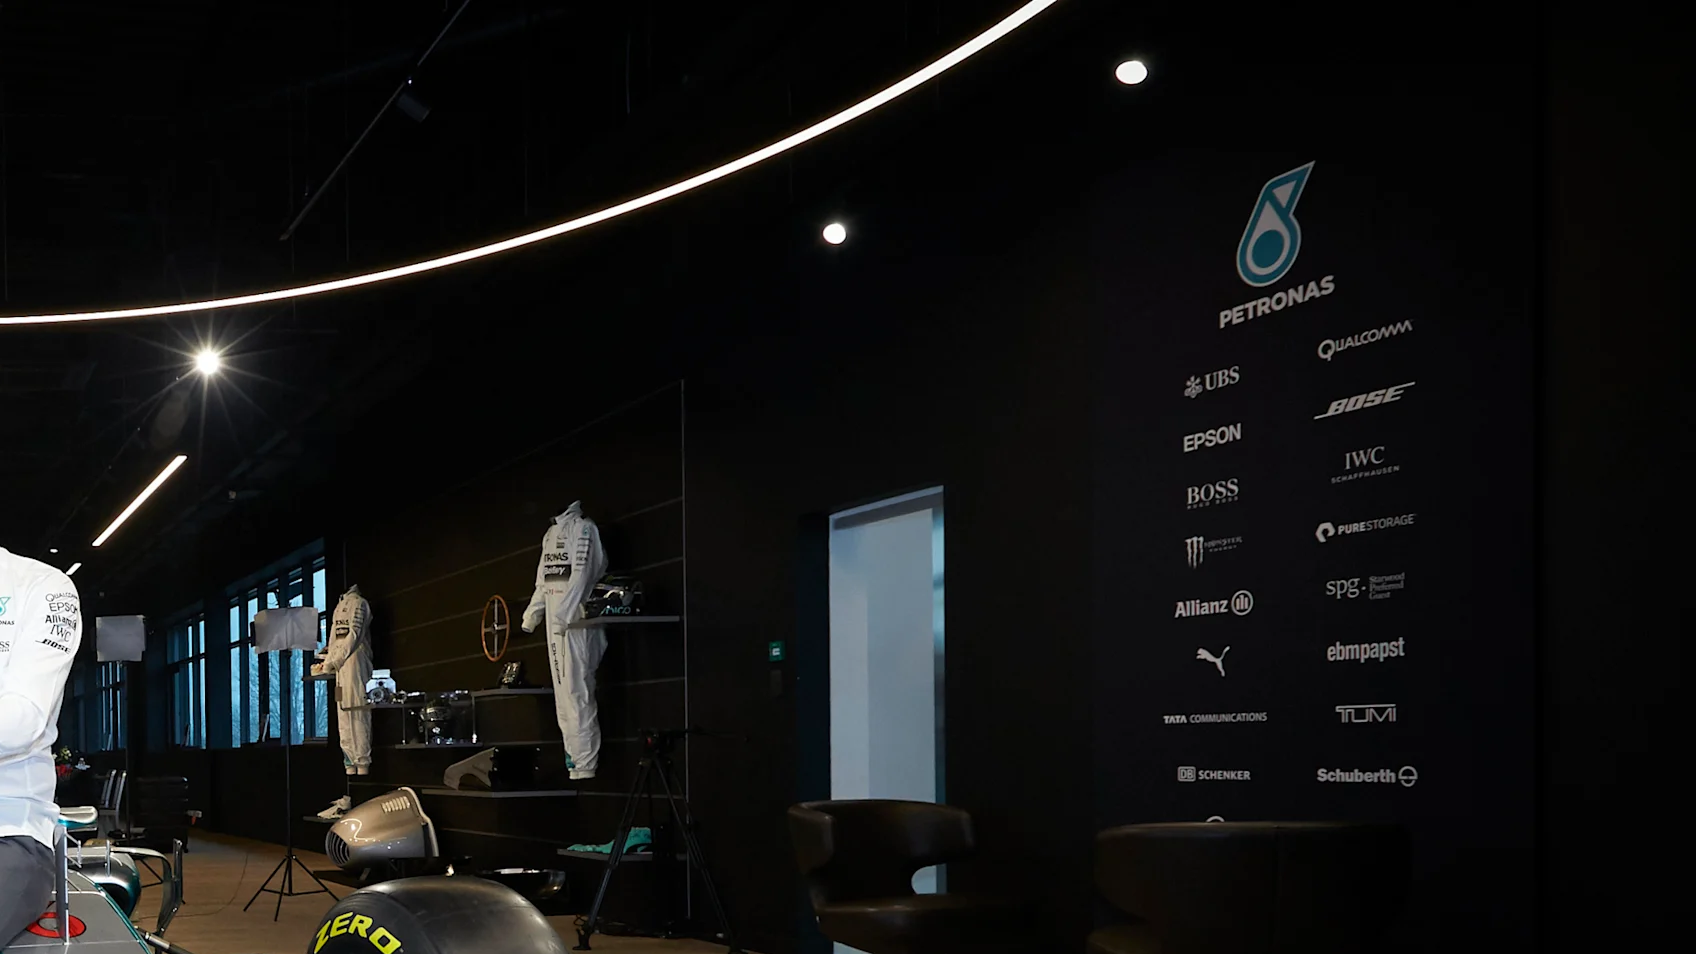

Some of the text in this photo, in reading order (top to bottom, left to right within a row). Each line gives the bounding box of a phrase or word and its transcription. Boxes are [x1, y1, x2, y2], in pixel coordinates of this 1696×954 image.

[1219, 275, 1335, 329] PETRONAS
[1318, 319, 1413, 362] QUALCOMM
[1205, 366, 1240, 391] UBS
[1316, 382, 1413, 419] BOSE
[1183, 423, 1242, 453] EPSON
[1345, 446, 1386, 471] IWC
[1331, 465, 1400, 484] SCHAFFHAUSEN
[1186, 479, 1239, 504] BOSS
[1174, 599, 1229, 618] Allianz
[50, 624, 71, 642] IWC
[38, 639, 72, 655] BOSE
[1326, 636, 1405, 663] ebmpapst
[1163, 712, 1267, 724] TATA COMMUNICATIONS
[1335, 704, 1396, 723] TUMI
[1179, 769, 1251, 781] DB SCHENKER
[1316, 768, 1396, 783] Schuberth
